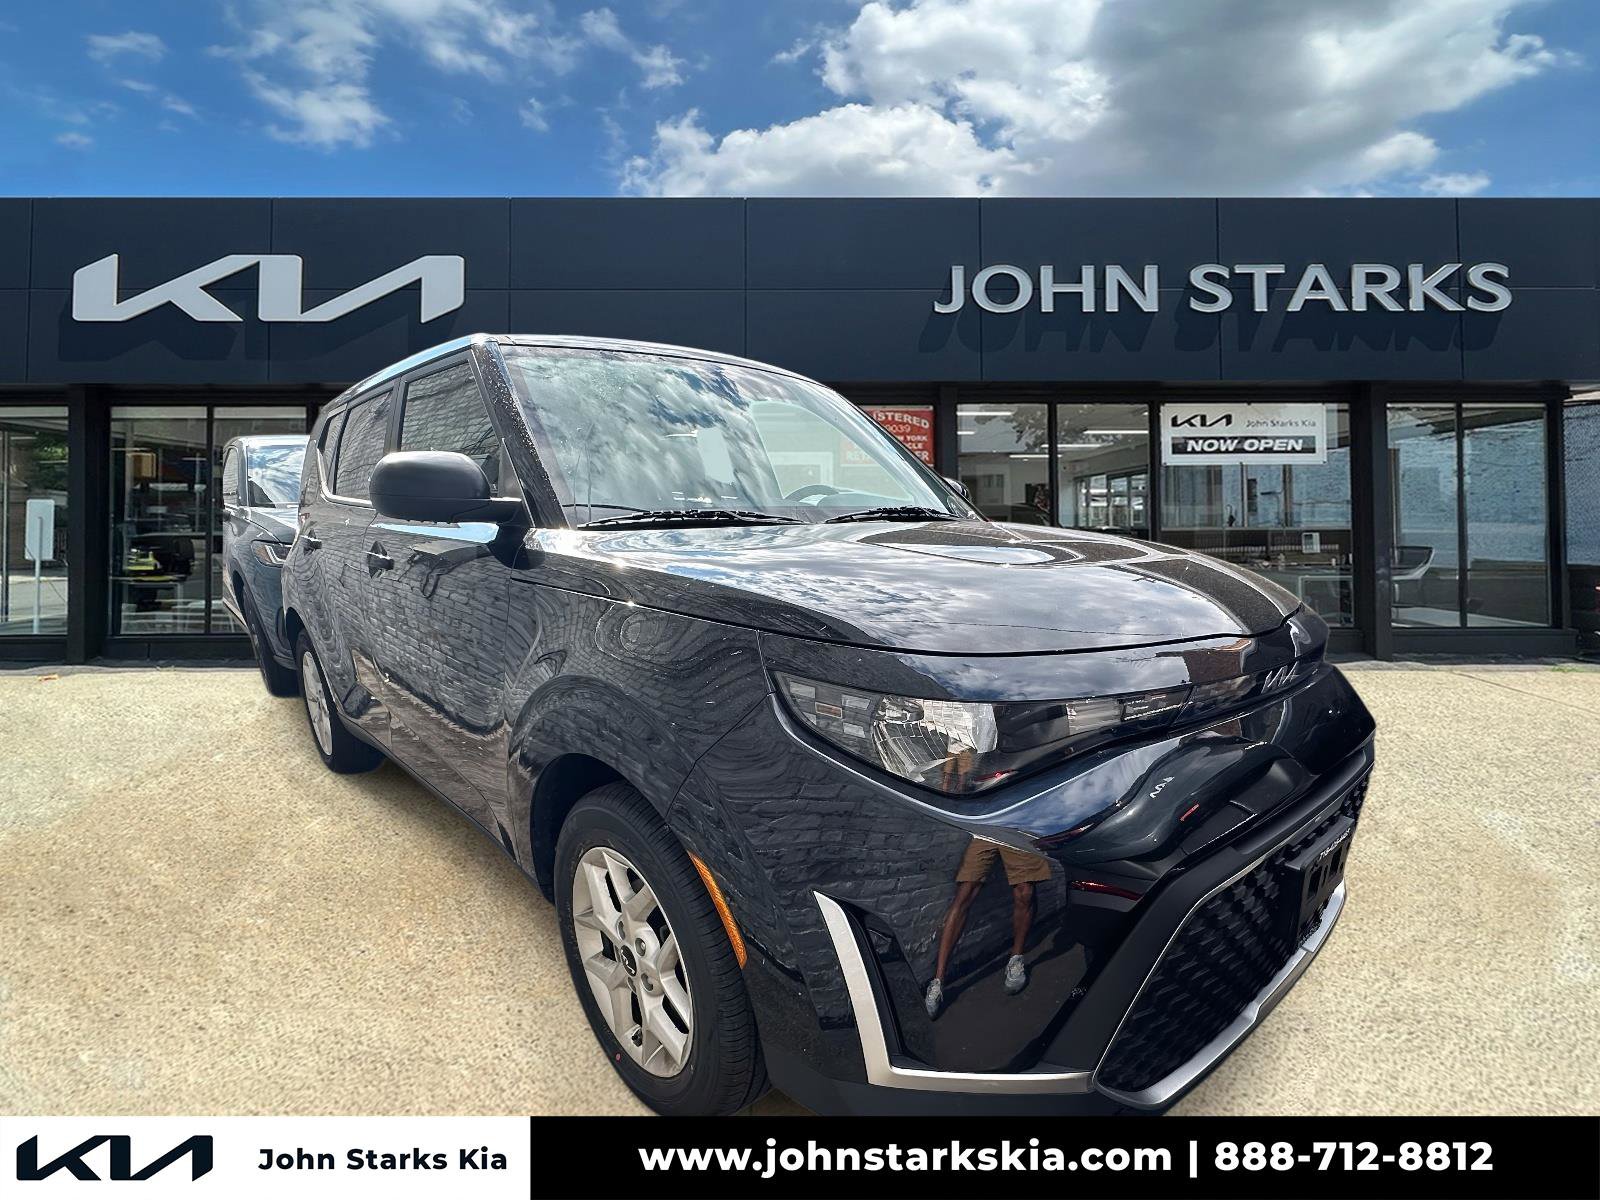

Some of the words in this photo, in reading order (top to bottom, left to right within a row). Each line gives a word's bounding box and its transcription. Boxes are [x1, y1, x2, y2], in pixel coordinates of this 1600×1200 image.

[933, 264, 1159, 314] JOHN
[1189, 262, 1512, 313] STARKS
[873, 411, 930, 429] ISTERED
[1246, 419, 1271, 428] John
[1271, 418, 1299, 428] Starks
[1301, 418, 1316, 428] Kia
[905, 434, 929, 442] YORK
[1186, 439, 1239, 452] NOW
[1243, 438, 1304, 452] OPEN
